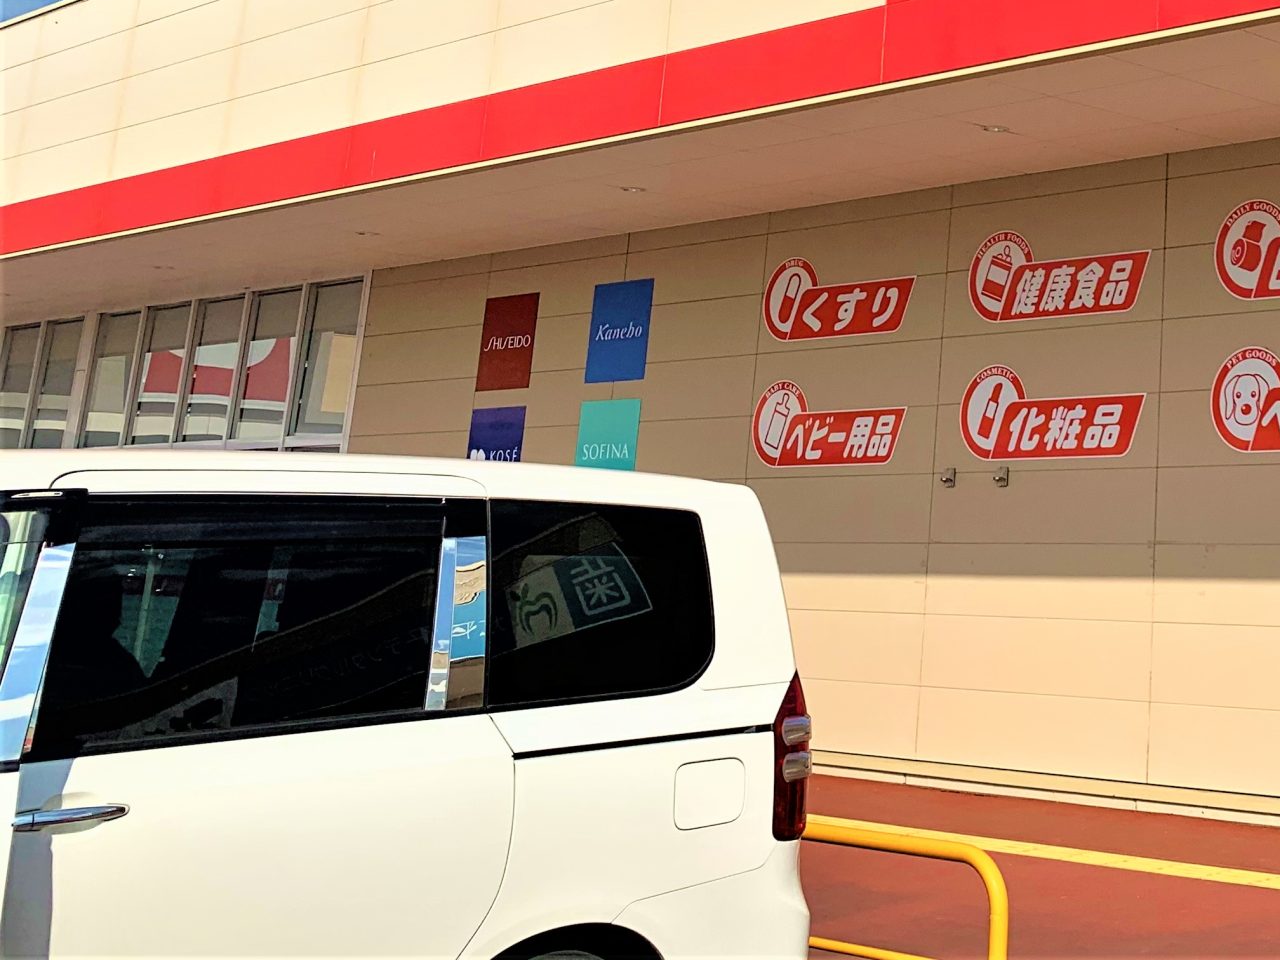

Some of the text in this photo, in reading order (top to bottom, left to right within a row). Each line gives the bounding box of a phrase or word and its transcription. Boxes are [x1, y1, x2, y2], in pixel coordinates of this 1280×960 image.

[1226, 203, 1251, 227] DAILY
[977, 233, 1029, 259] HEALTH FOODS
[1011, 259, 1133, 316] 健康食品
[802, 286, 899, 332] くすり
[484, 334, 531, 351] SHISEIDO
[595, 321, 643, 341] Kanebo
[1226, 350, 1277, 369] PET GOODS
[976, 367, 1015, 383] COSMETIC
[786, 414, 896, 460] ベビー用品
[1007, 404, 1123, 452] 化粧品
[582, 444, 629, 460] SOFINA
